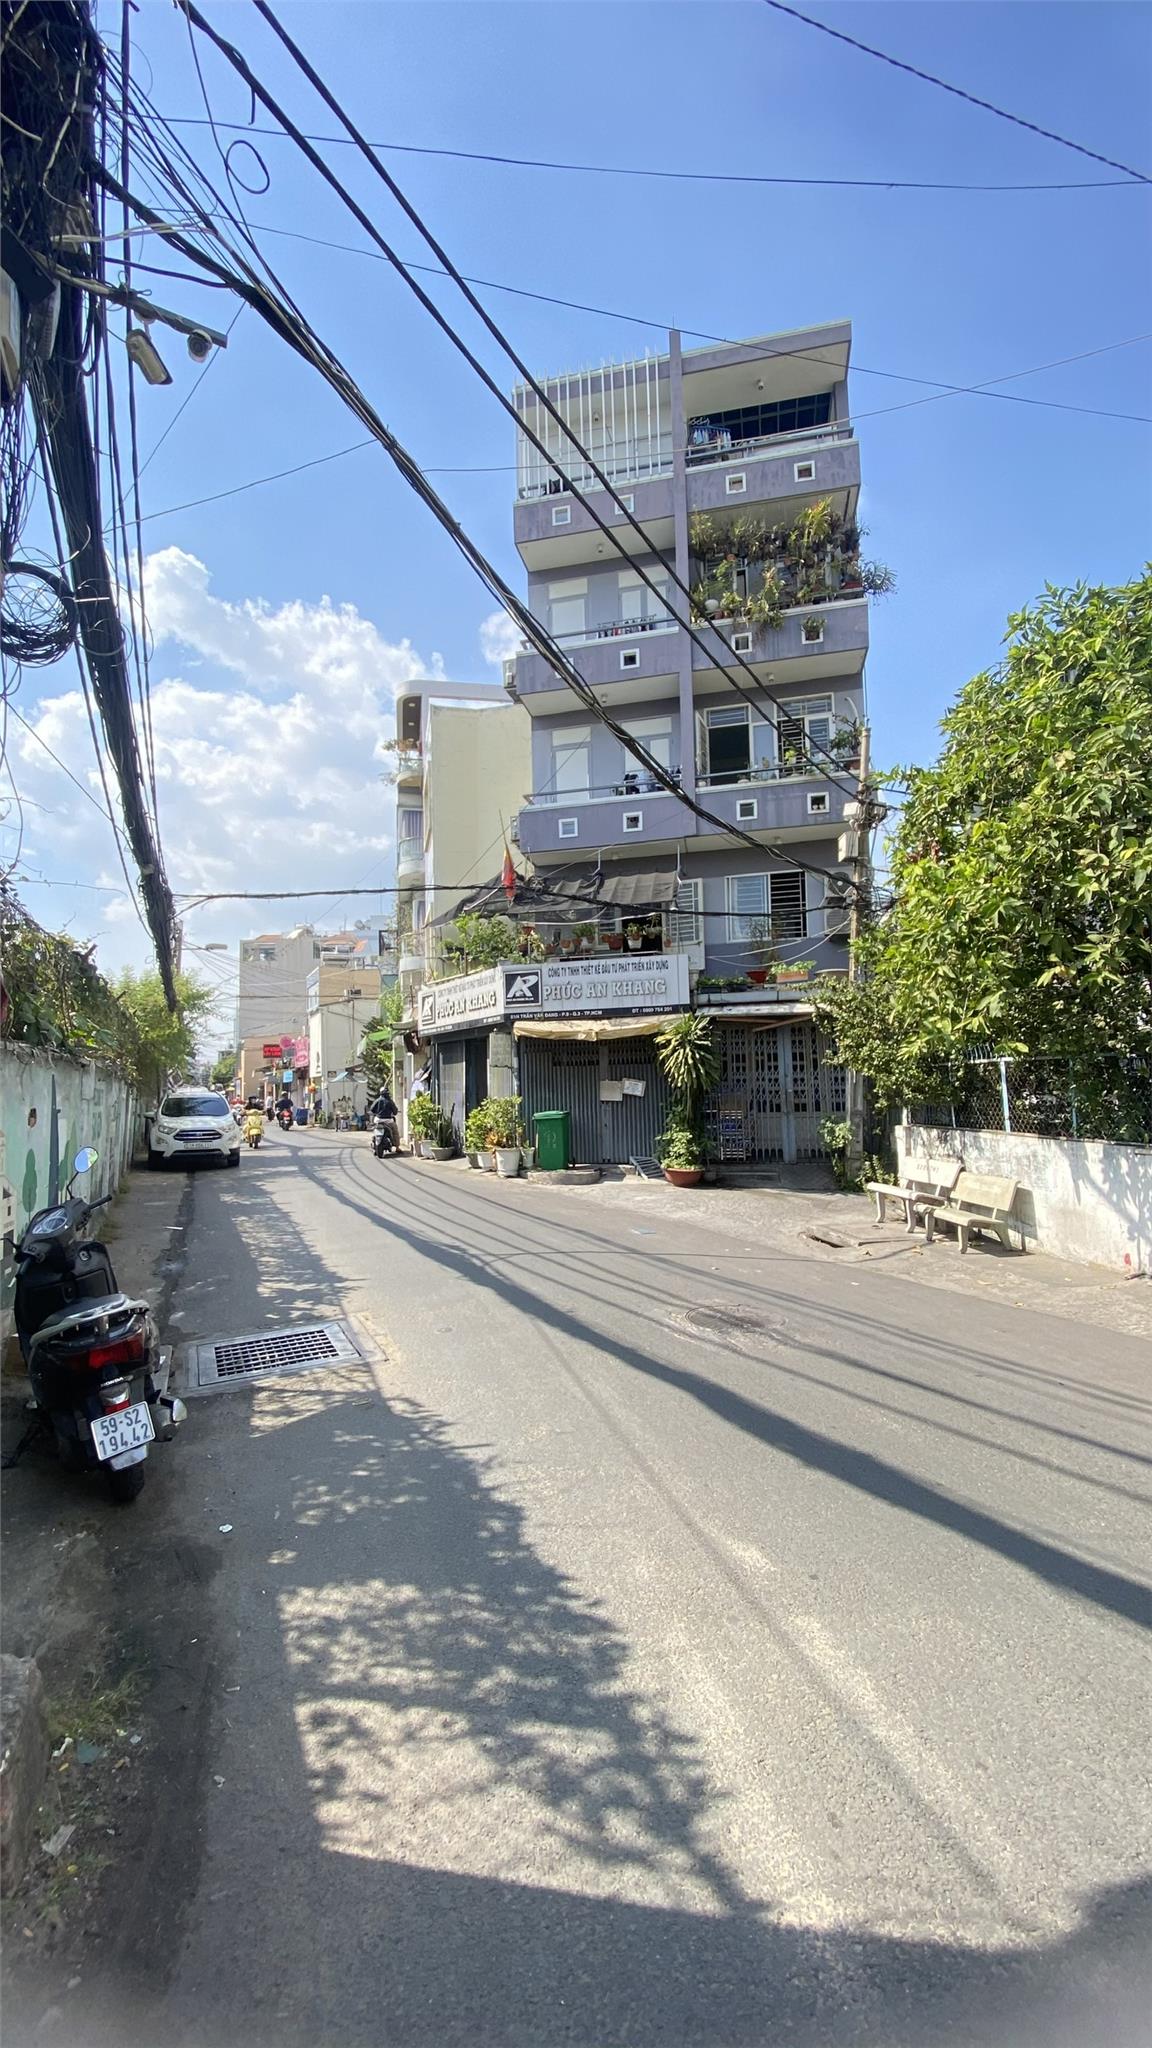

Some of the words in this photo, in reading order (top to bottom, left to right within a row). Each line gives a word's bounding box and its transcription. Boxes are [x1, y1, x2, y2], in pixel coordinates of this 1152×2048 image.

[466, 991, 496, 1012] KHANG
[544, 980, 582, 1001] PHÚC
[586, 983, 608, 998] AN
[612, 979, 666, 997] KHANG
[100, 1408, 142, 1437] 59-S2
[99, 1423, 150, 1456] 194.42
